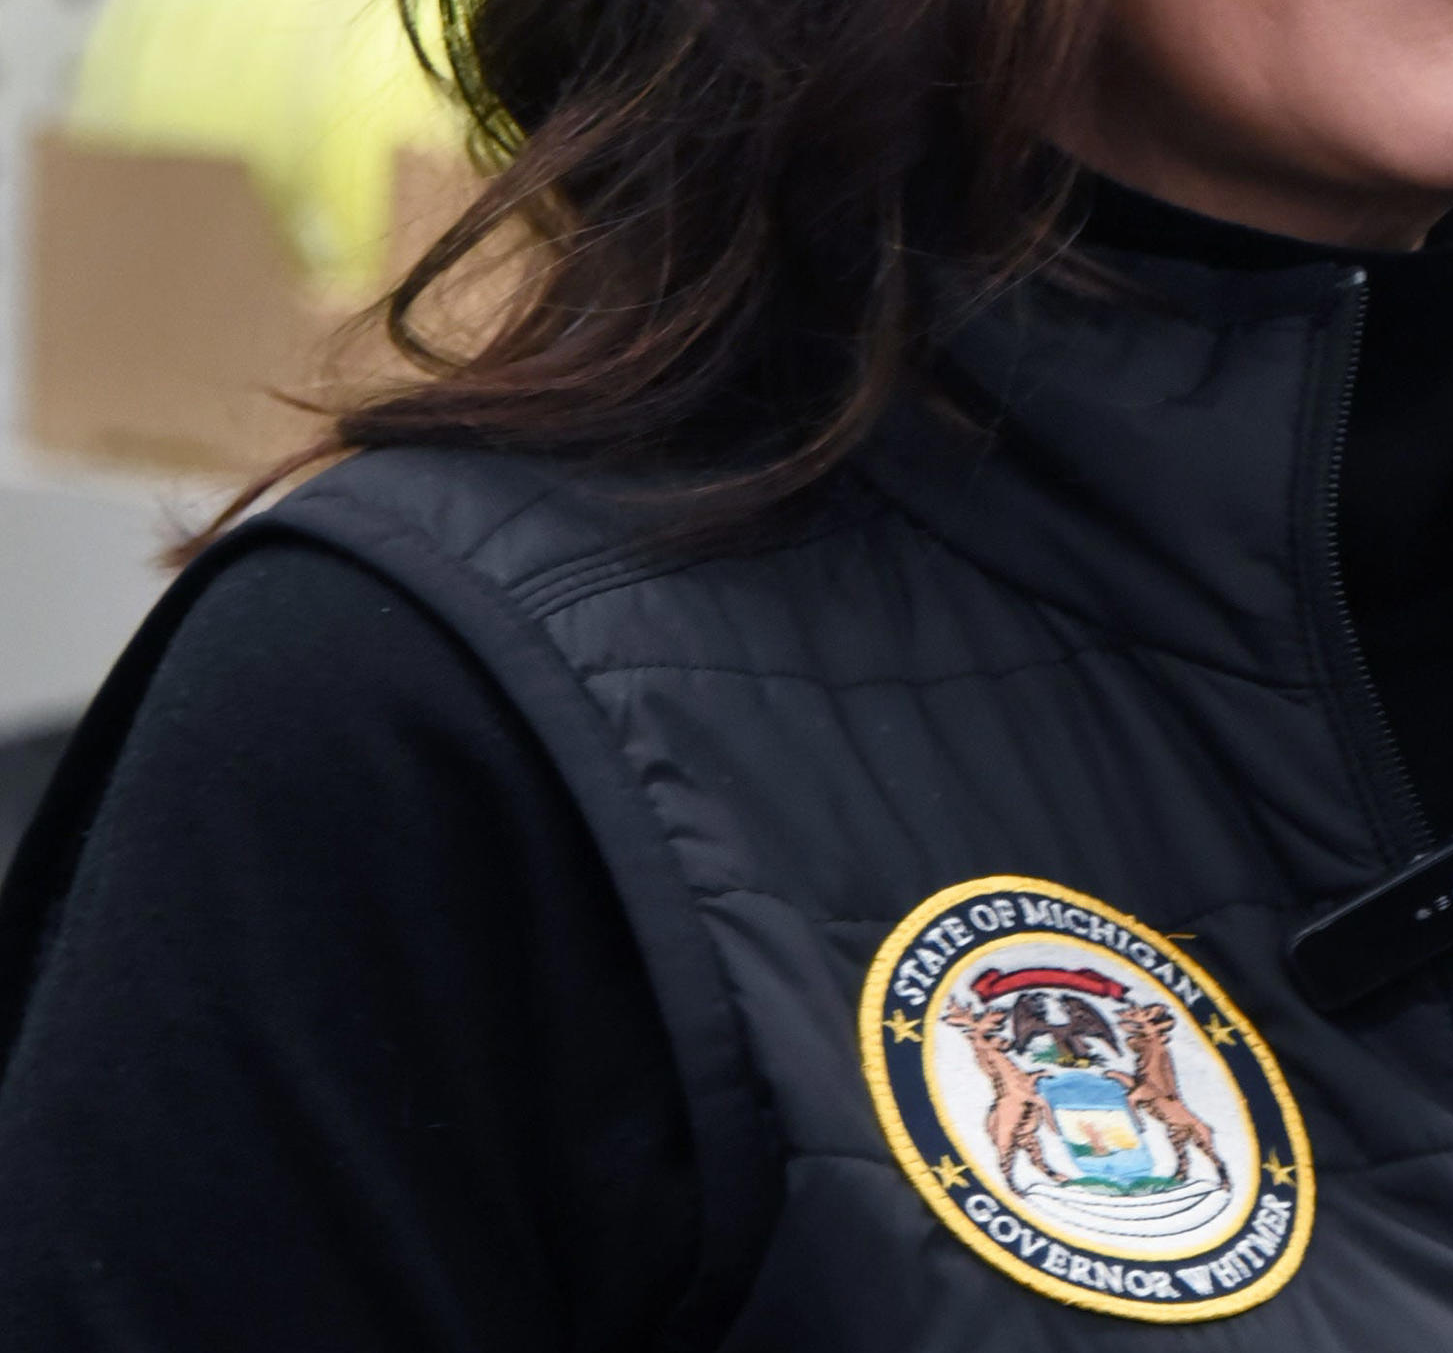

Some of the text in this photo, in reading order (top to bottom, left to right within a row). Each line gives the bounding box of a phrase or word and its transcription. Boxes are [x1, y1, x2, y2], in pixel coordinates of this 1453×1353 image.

[892, 896, 1206, 1007] STATE OF MICHIGAN
[964, 1192, 1293, 1299] GOVERNOR WHITMER
